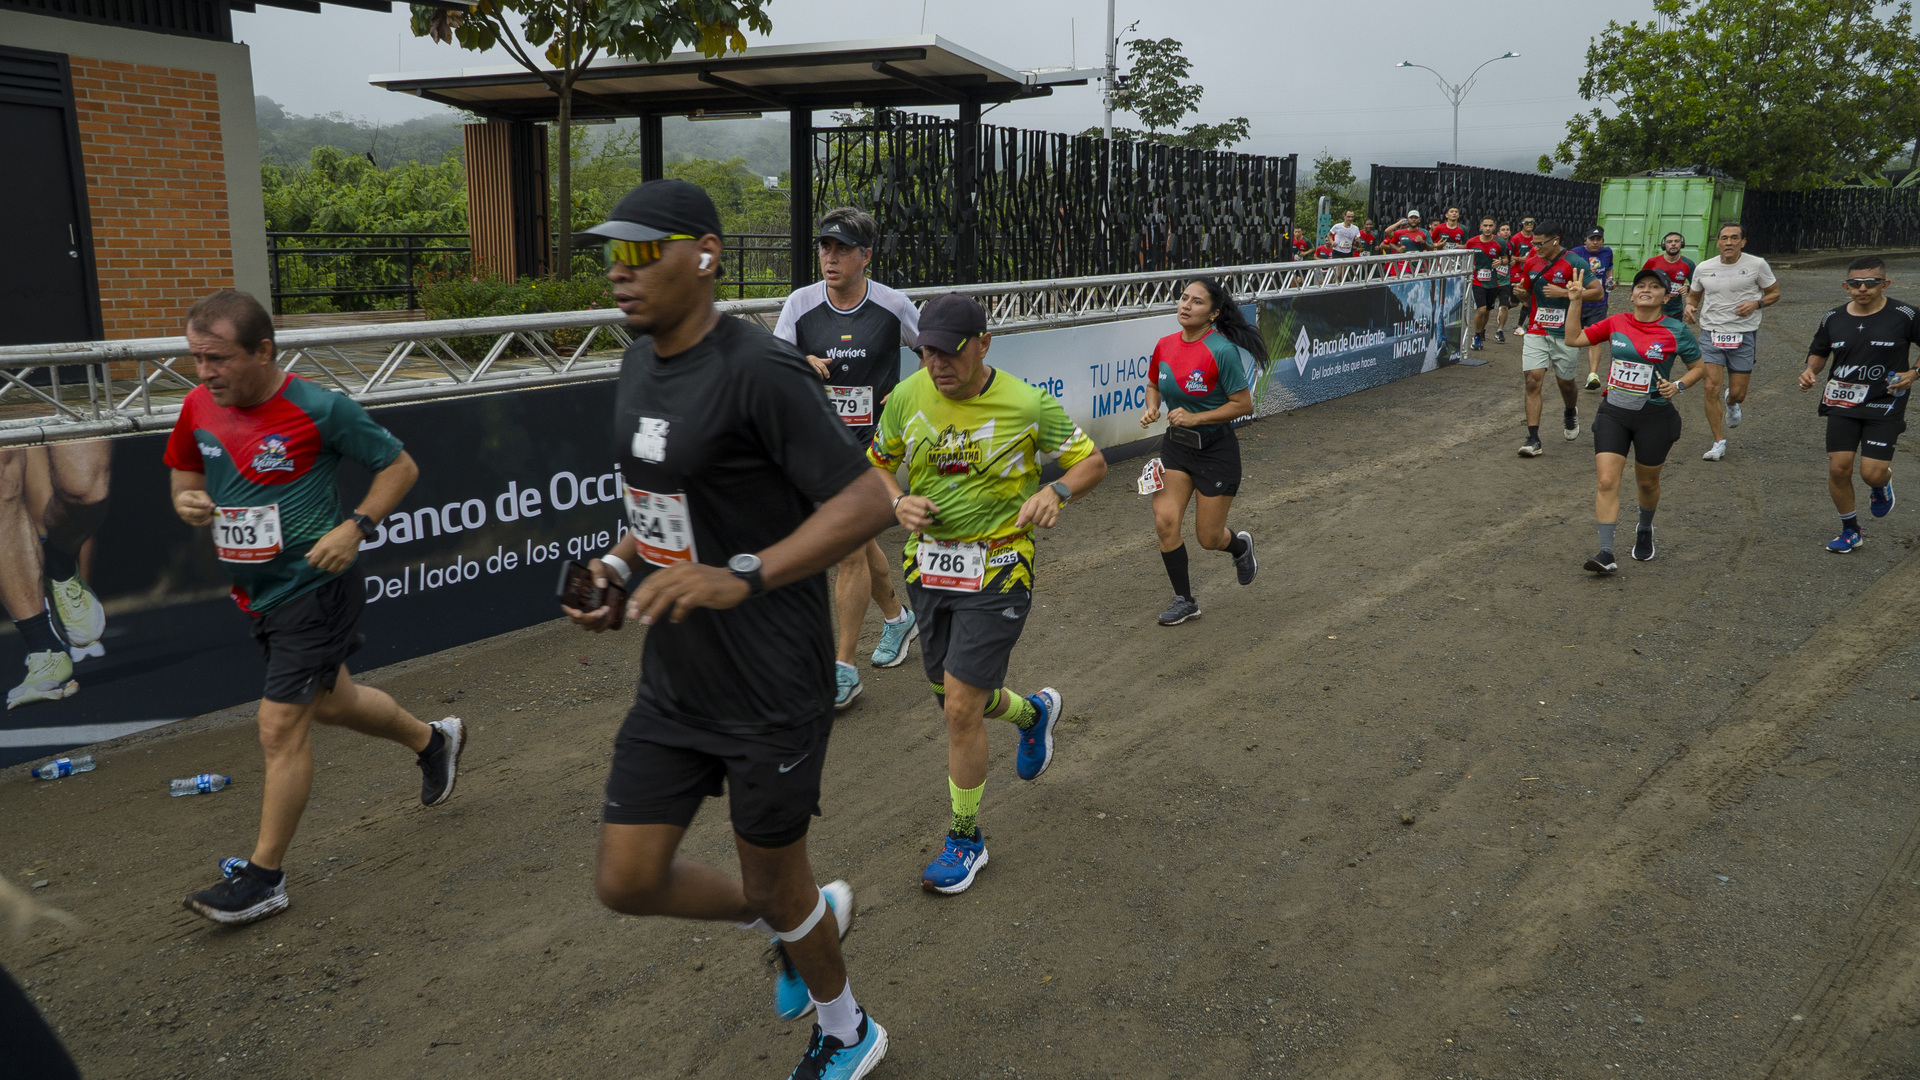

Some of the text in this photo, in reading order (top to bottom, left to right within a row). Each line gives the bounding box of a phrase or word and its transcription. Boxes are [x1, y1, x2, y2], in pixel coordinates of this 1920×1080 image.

[1540, 313, 1560, 321] 2099
[1393, 322, 1403, 338] TU
[1716, 334, 1737, 342] 1691
[1313, 329, 1385, 357] Banco de Occidente
[1393, 337, 1428, 359] IMPACTA.
[826, 347, 866, 359] Warriors
[1090, 355, 1153, 388] TU HAC
[1312, 366, 1321, 380] Del
[1334, 362, 1341, 374] de
[1342, 360, 1350, 372] los
[1350, 361, 1360, 373] que
[1618, 369, 1639, 382] 717
[1831, 389, 1855, 400] 580
[496, 481, 542, 523] de
[219, 526, 257, 545] 703
[364, 566, 410, 605] Del
[420, 555, 480, 591] lado
[486, 546, 519, 574] de
[526, 539, 560, 565] los
[567, 530, 611, 560] que
[928, 552, 965, 574] 786
